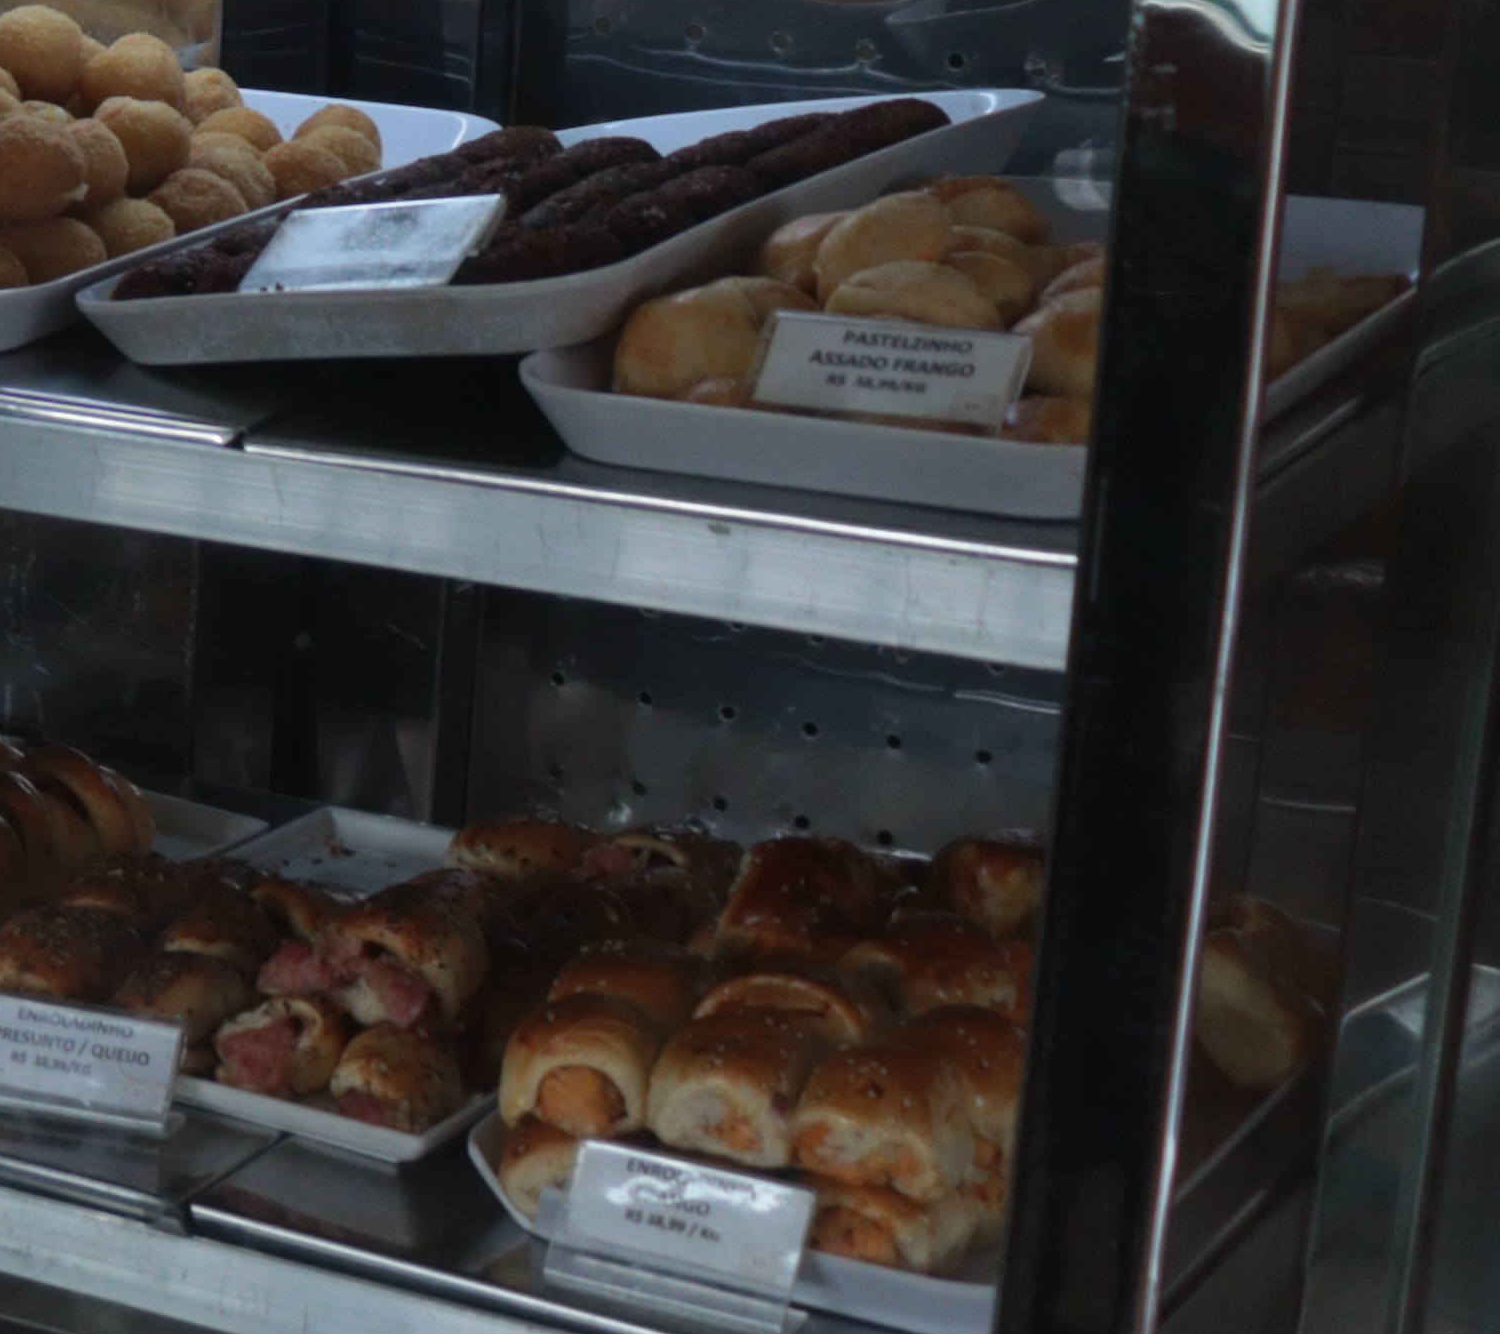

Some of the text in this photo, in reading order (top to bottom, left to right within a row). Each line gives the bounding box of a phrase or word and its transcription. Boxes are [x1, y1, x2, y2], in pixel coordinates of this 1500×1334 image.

[844, 331, 973, 354] PASTELZINHO
[810, 351, 976, 378] ASSADO FRANGO
[827, 373, 846, 386] R$
[19, 1007, 134, 1040] ENROLADINHO
[12, 1052, 26, 1064] R$
[79, 1041, 88, 1056] /
[92, 1044, 150, 1067] QUEIJO
[626, 1209, 642, 1222] R$
[649, 1213, 685, 1232] 38,99
[701, 1227, 720, 1242] KG
